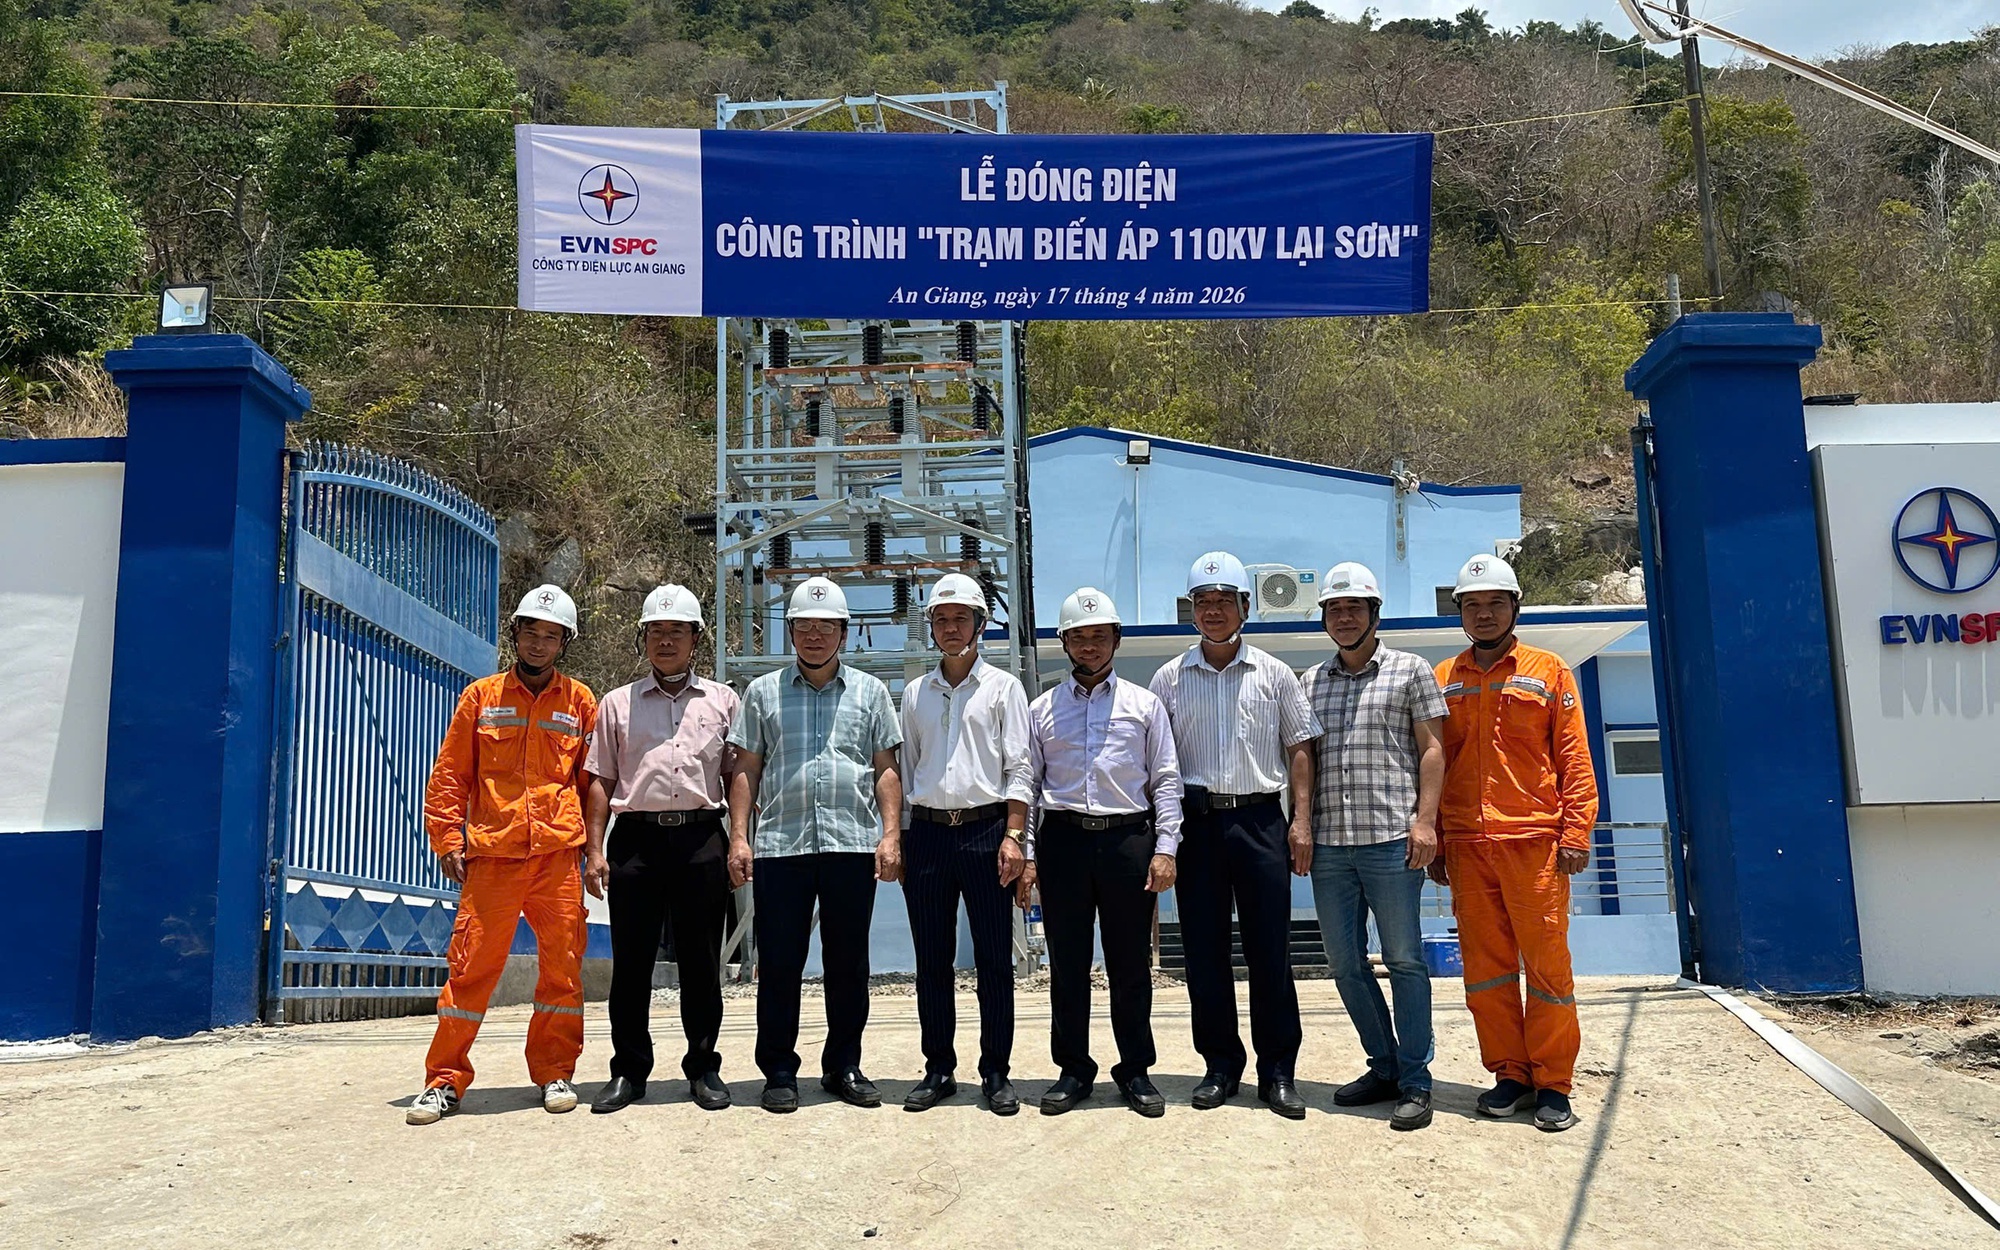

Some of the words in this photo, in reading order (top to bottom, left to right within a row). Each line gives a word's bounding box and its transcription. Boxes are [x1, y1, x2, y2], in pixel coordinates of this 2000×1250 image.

[961, 154, 996, 201] LỄ
[1005, 160, 1093, 202] ĐÓNG
[1101, 160, 1176, 209] ĐIỆN
[560, 235, 658, 256] EVNSPC
[716, 216, 803, 259] CÔNG
[812, 218, 906, 260] TRÌNH
[918, 226, 1023, 268] "TRẠM
[1034, 216, 1107, 261] BIẾN
[1116, 220, 1159, 261] ÁP
[1170, 226, 1267, 261] 110KV
[1276, 226, 1324, 267] LẠI
[1334, 221, 1419, 259] SƠN"
[532, 256, 564, 271] CÔNG
[566, 260, 580, 272] TY
[582, 259, 607, 275] ĐIỆN
[609, 261, 632, 276] LỰC
[633, 262, 649, 274] AN
[652, 262, 686, 275] GIANG
[888, 286, 918, 304] An
[924, 286, 987, 309] Giang,
[993, 286, 1041, 309] ngày
[1047, 287, 1071, 305] 17
[1074, 286, 1131, 309] tháng
[1134, 287, 1147, 304] 4
[1151, 287, 1194, 304] năm
[1198, 286, 1247, 304] 2026
